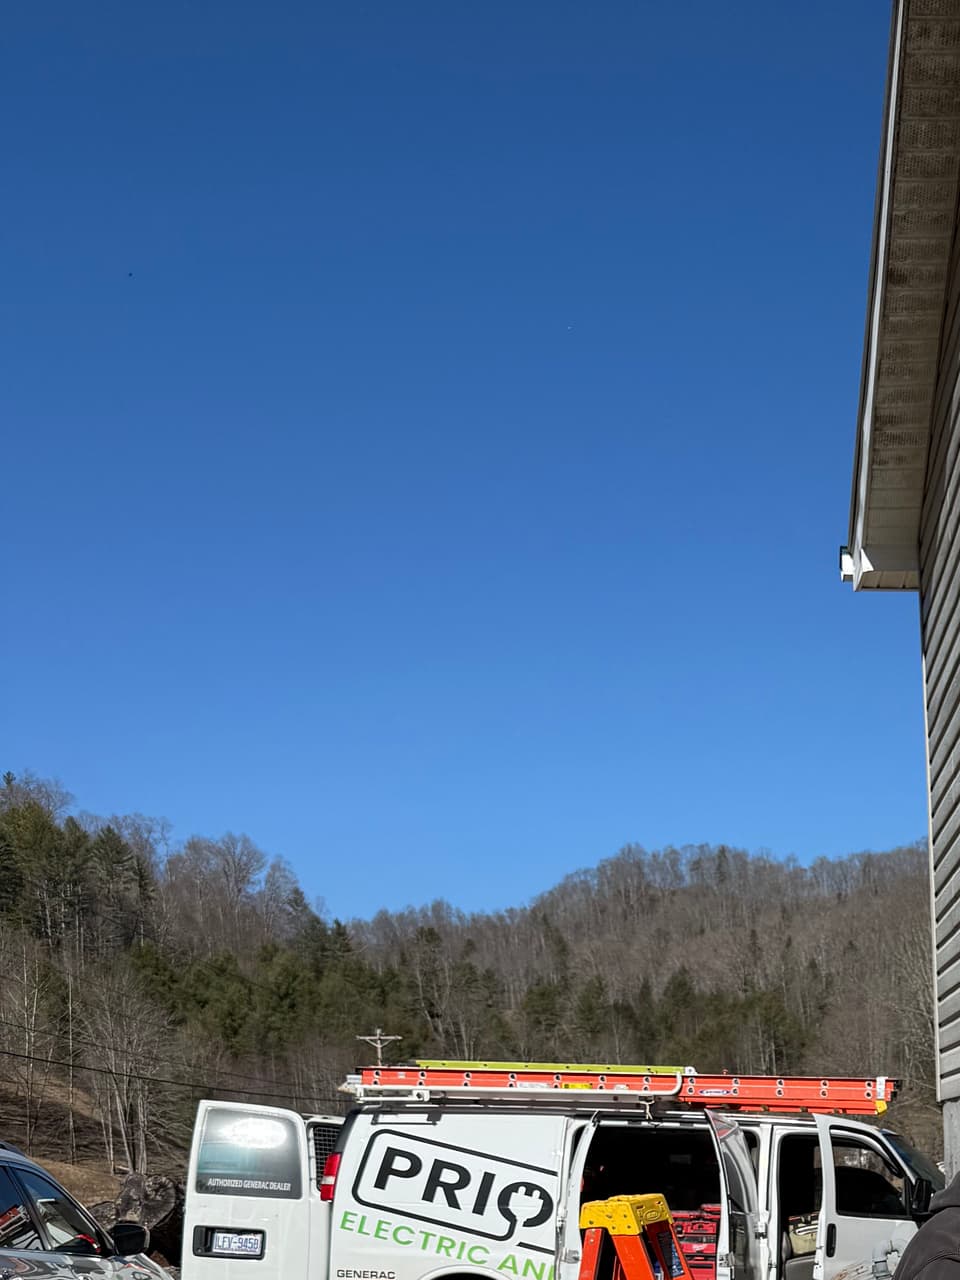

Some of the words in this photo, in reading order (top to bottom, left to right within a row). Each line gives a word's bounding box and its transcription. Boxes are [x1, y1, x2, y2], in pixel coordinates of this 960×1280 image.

[208, 1178, 242, 1188] AUTHORIZED
[243, 1180, 268, 1189] GENERAC
[269, 1182, 291, 1191] DEALER
[339, 1211, 490, 1265] ELECTRIC
[337, 1269, 396, 1280] GENERAC
